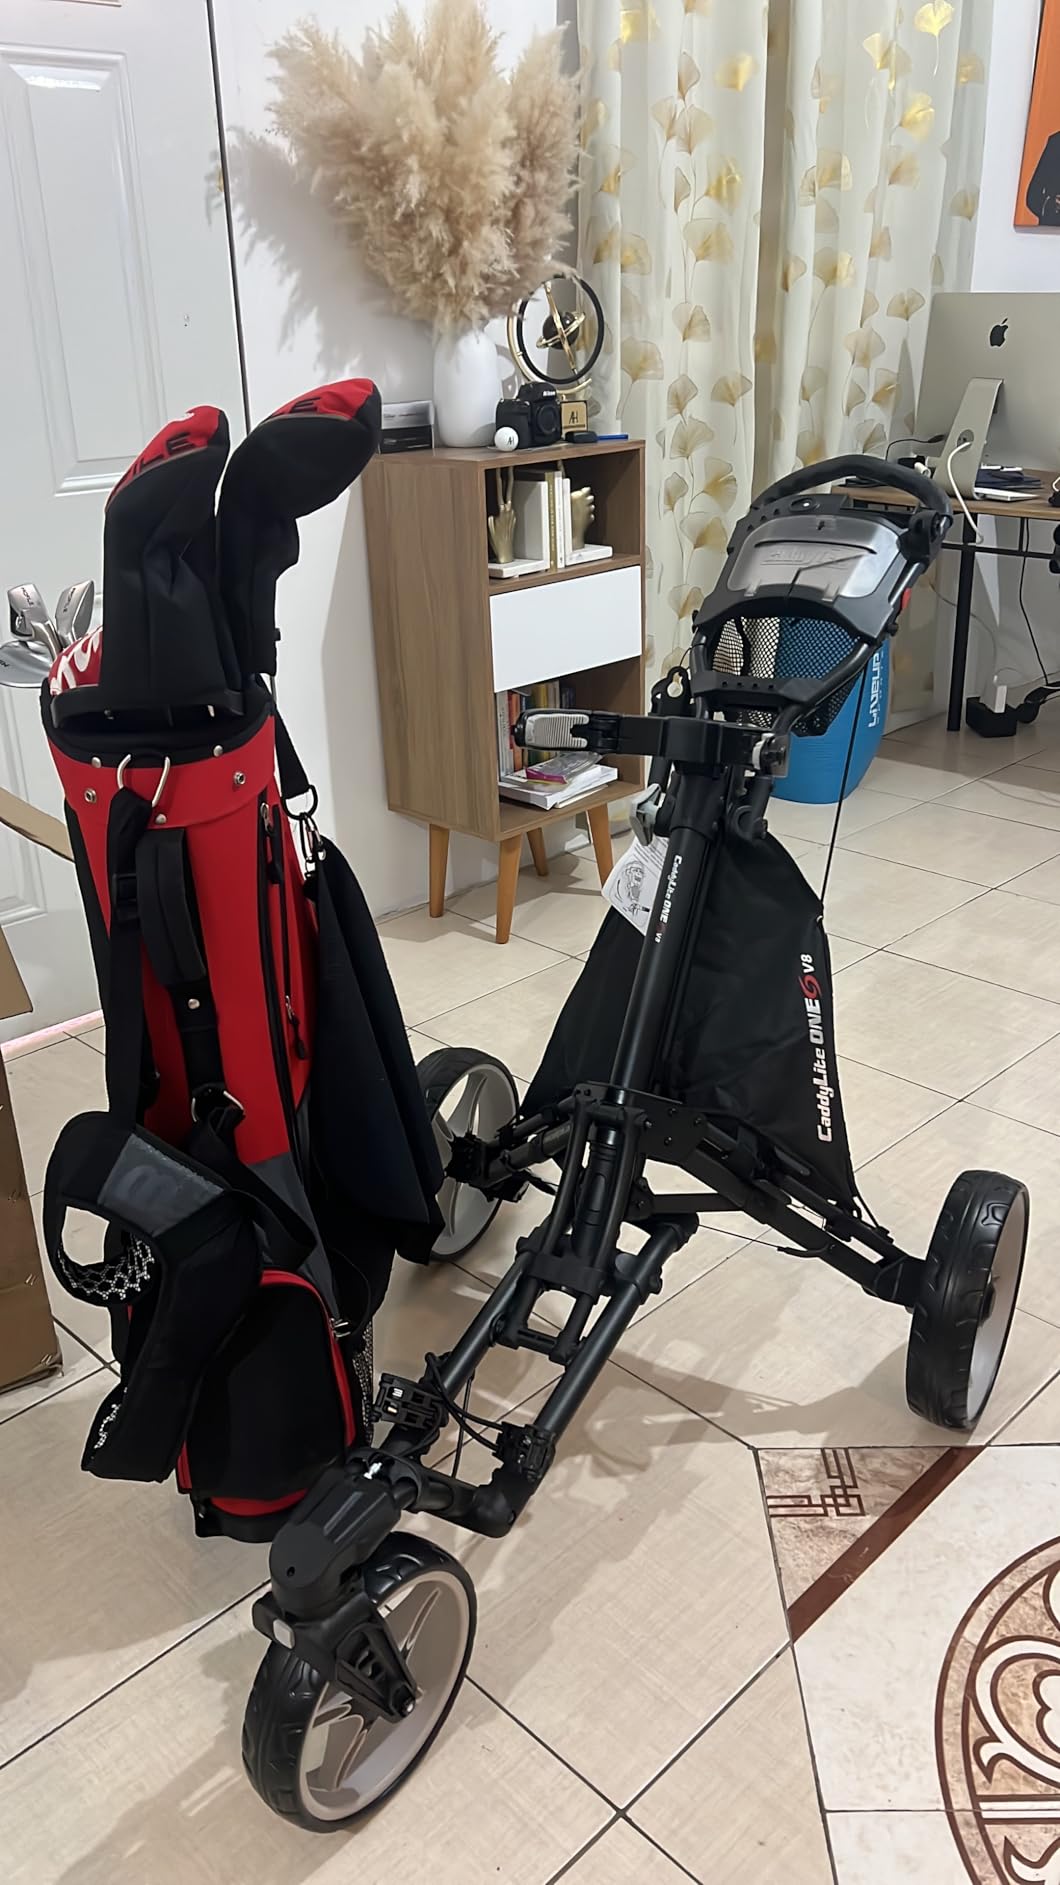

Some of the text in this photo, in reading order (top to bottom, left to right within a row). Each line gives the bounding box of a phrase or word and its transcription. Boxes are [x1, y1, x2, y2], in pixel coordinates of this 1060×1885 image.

[801, 954, 834, 1142] CaddyLite ONE V8
